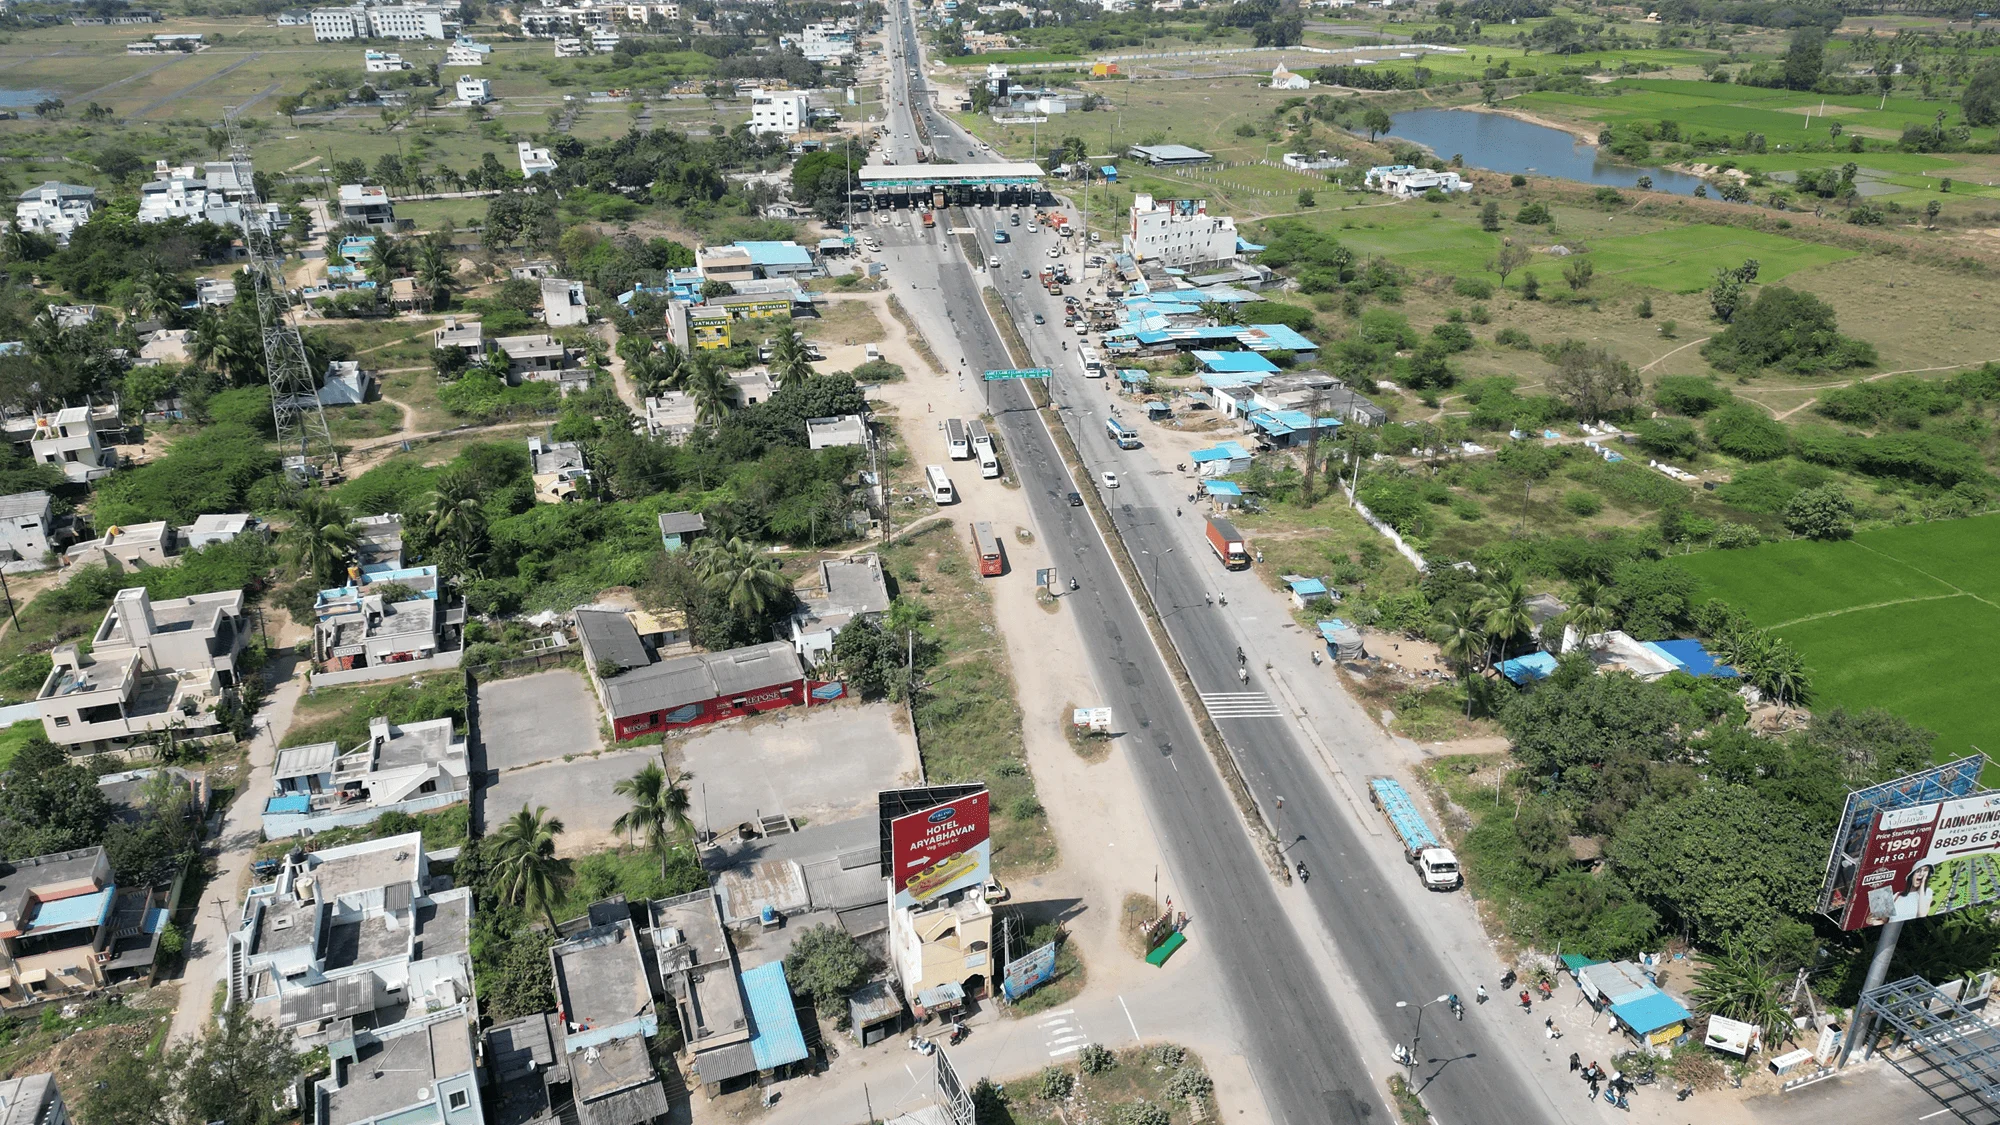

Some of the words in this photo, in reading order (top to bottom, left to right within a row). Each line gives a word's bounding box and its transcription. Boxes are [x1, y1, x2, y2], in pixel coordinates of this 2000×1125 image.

[746, 692, 778, 704] REPOSE
[623, 722, 650, 734] REPOSE
[1939, 809, 2000, 830] LAUNCHING
[926, 820, 959, 836] HOTEL
[1892, 829, 1915, 838] Starting
[910, 824, 975, 851] ARYABHAVAN
[1934, 834, 1968, 849] 8889
[1971, 831, 1988, 843] 66
[1990, 829, 2000, 840] 8
[1873, 855, 1890, 865] PER
